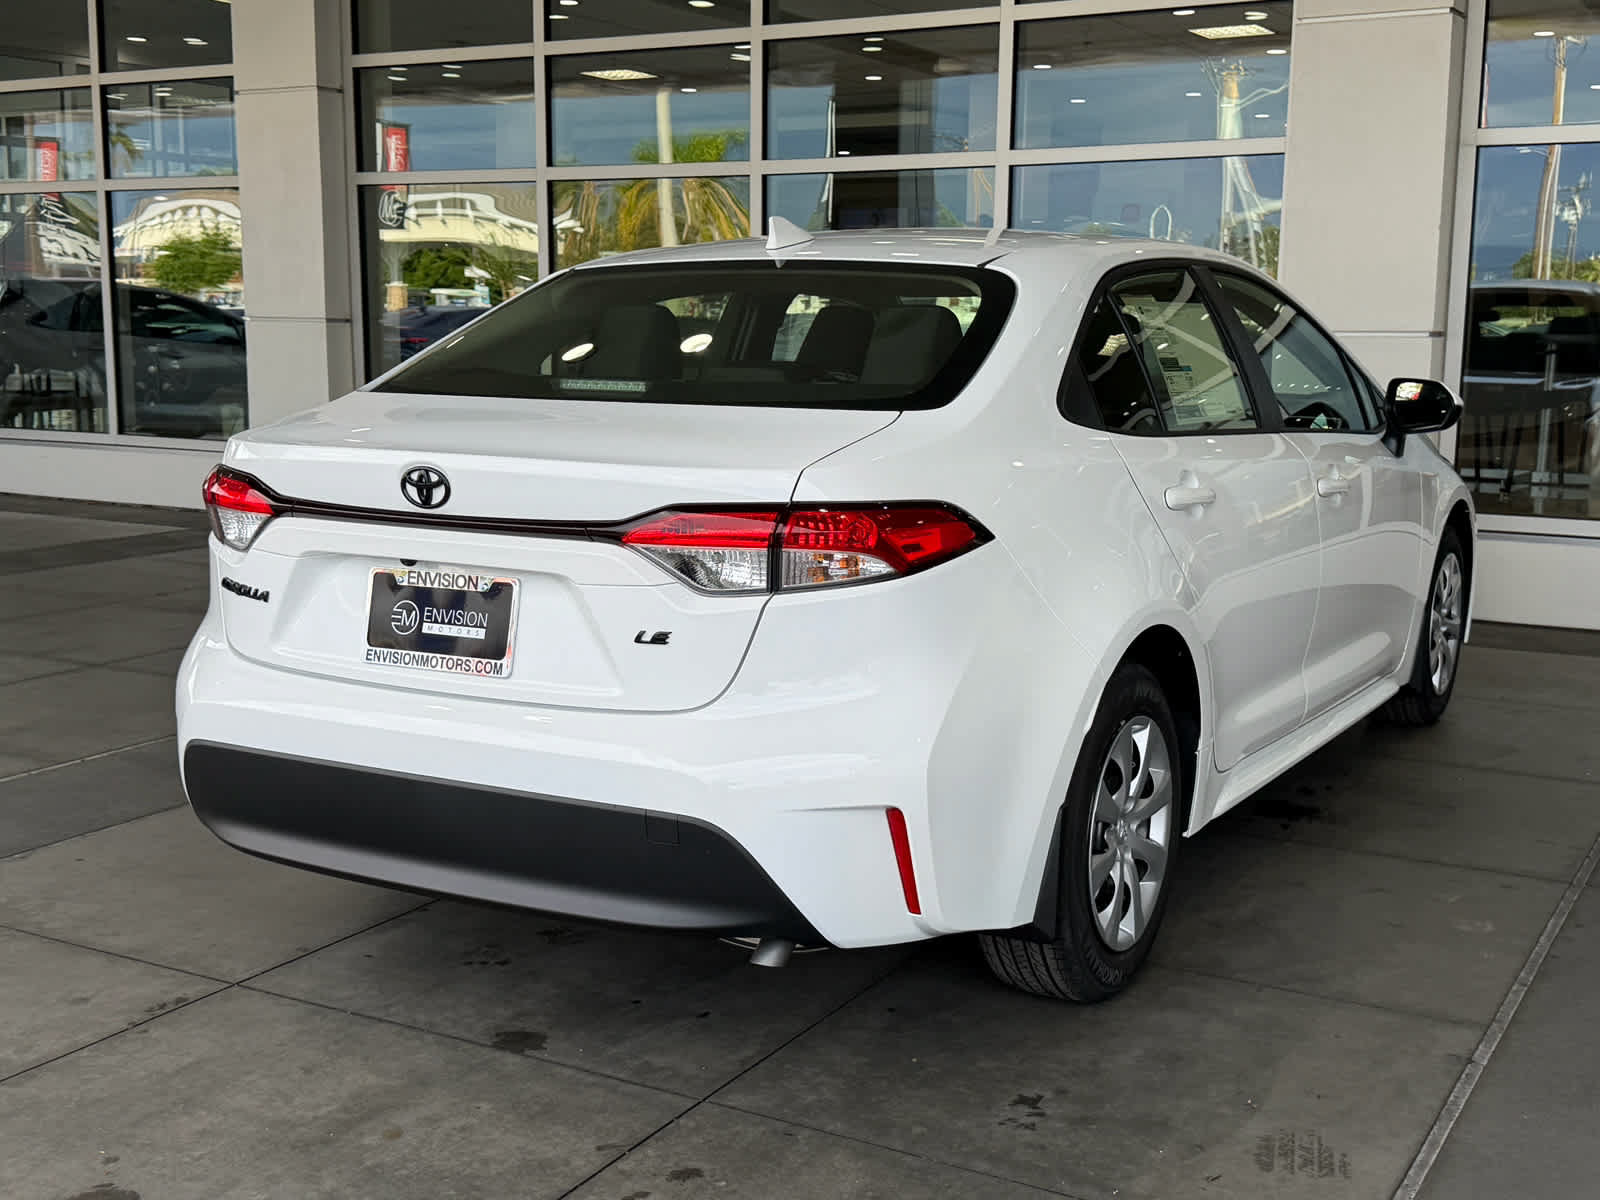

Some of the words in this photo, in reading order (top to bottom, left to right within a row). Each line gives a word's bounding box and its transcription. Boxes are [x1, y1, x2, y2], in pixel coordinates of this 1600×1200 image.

[407, 571, 479, 590] ENVISION
[423, 607, 488, 627] ENVISION
[427, 625, 480, 637] MOTORS
[634, 630, 672, 645] LE
[365, 648, 503, 676] ENVISIONMOTORS.COM
